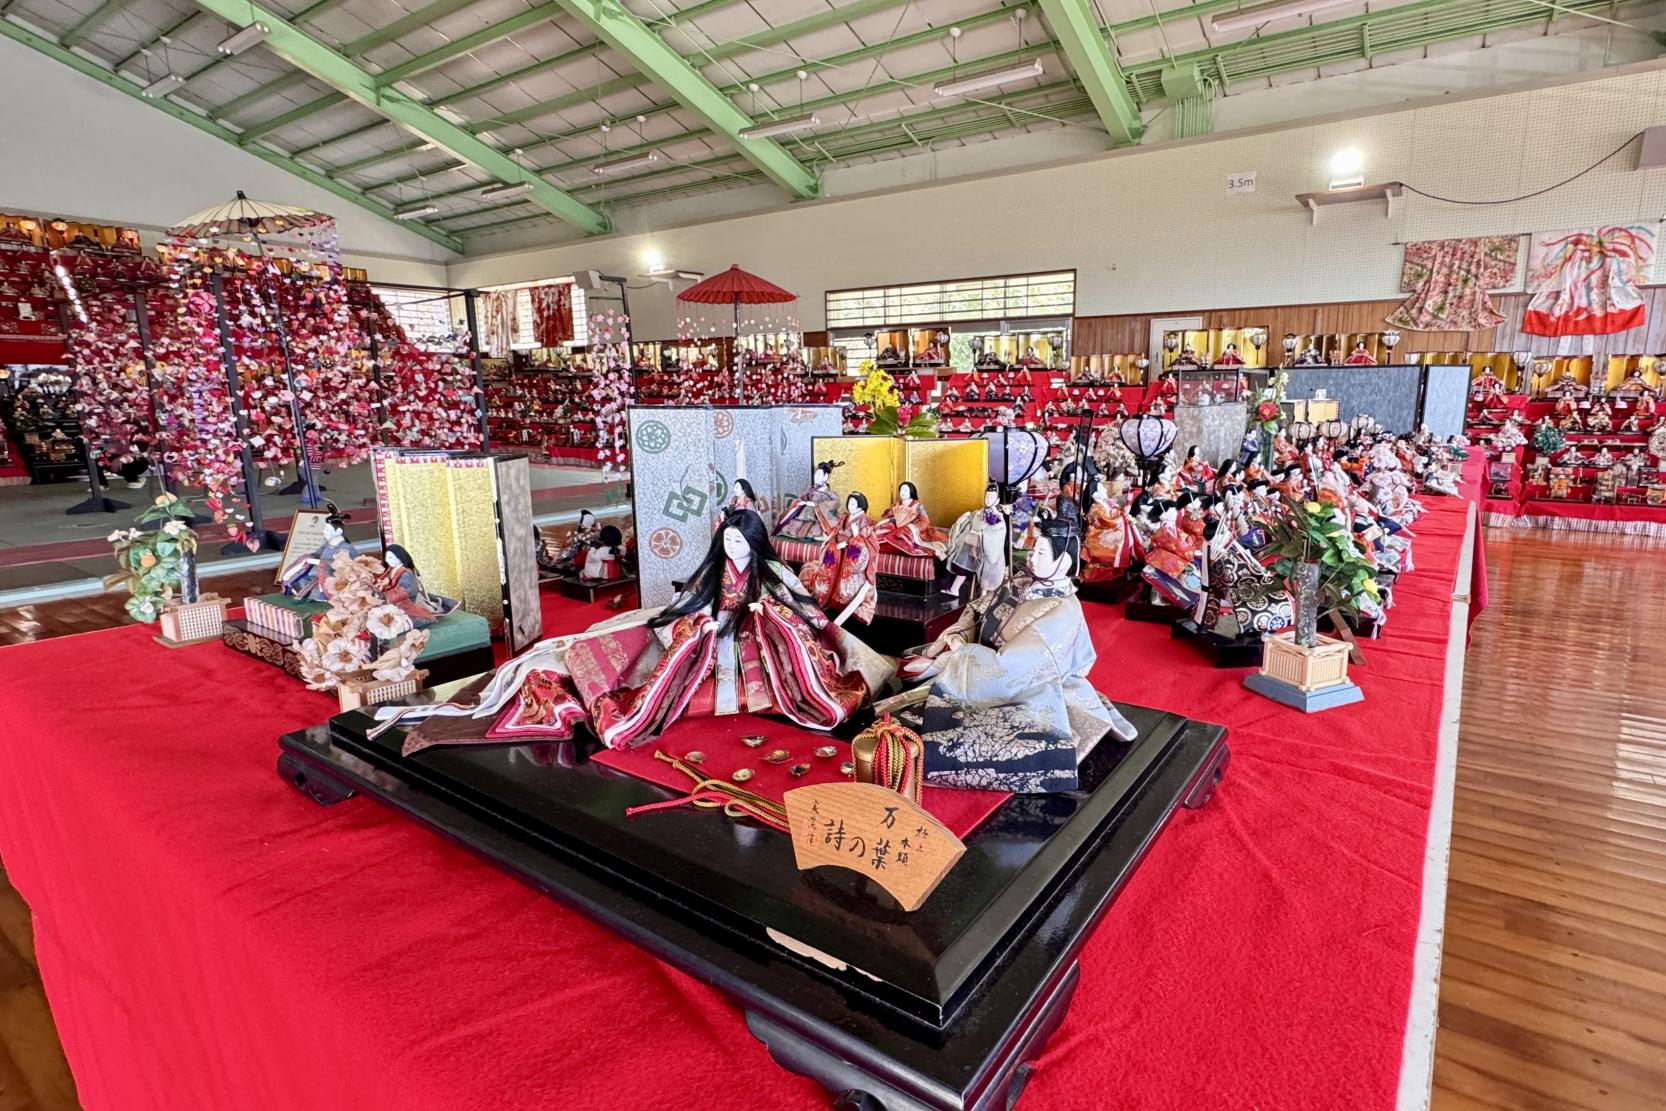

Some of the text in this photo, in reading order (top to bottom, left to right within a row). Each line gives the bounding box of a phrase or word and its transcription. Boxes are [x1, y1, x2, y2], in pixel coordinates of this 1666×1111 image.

[1228, 178, 1254, 189] 3.5m
[823, 806, 900, 871] 万葉の詩
